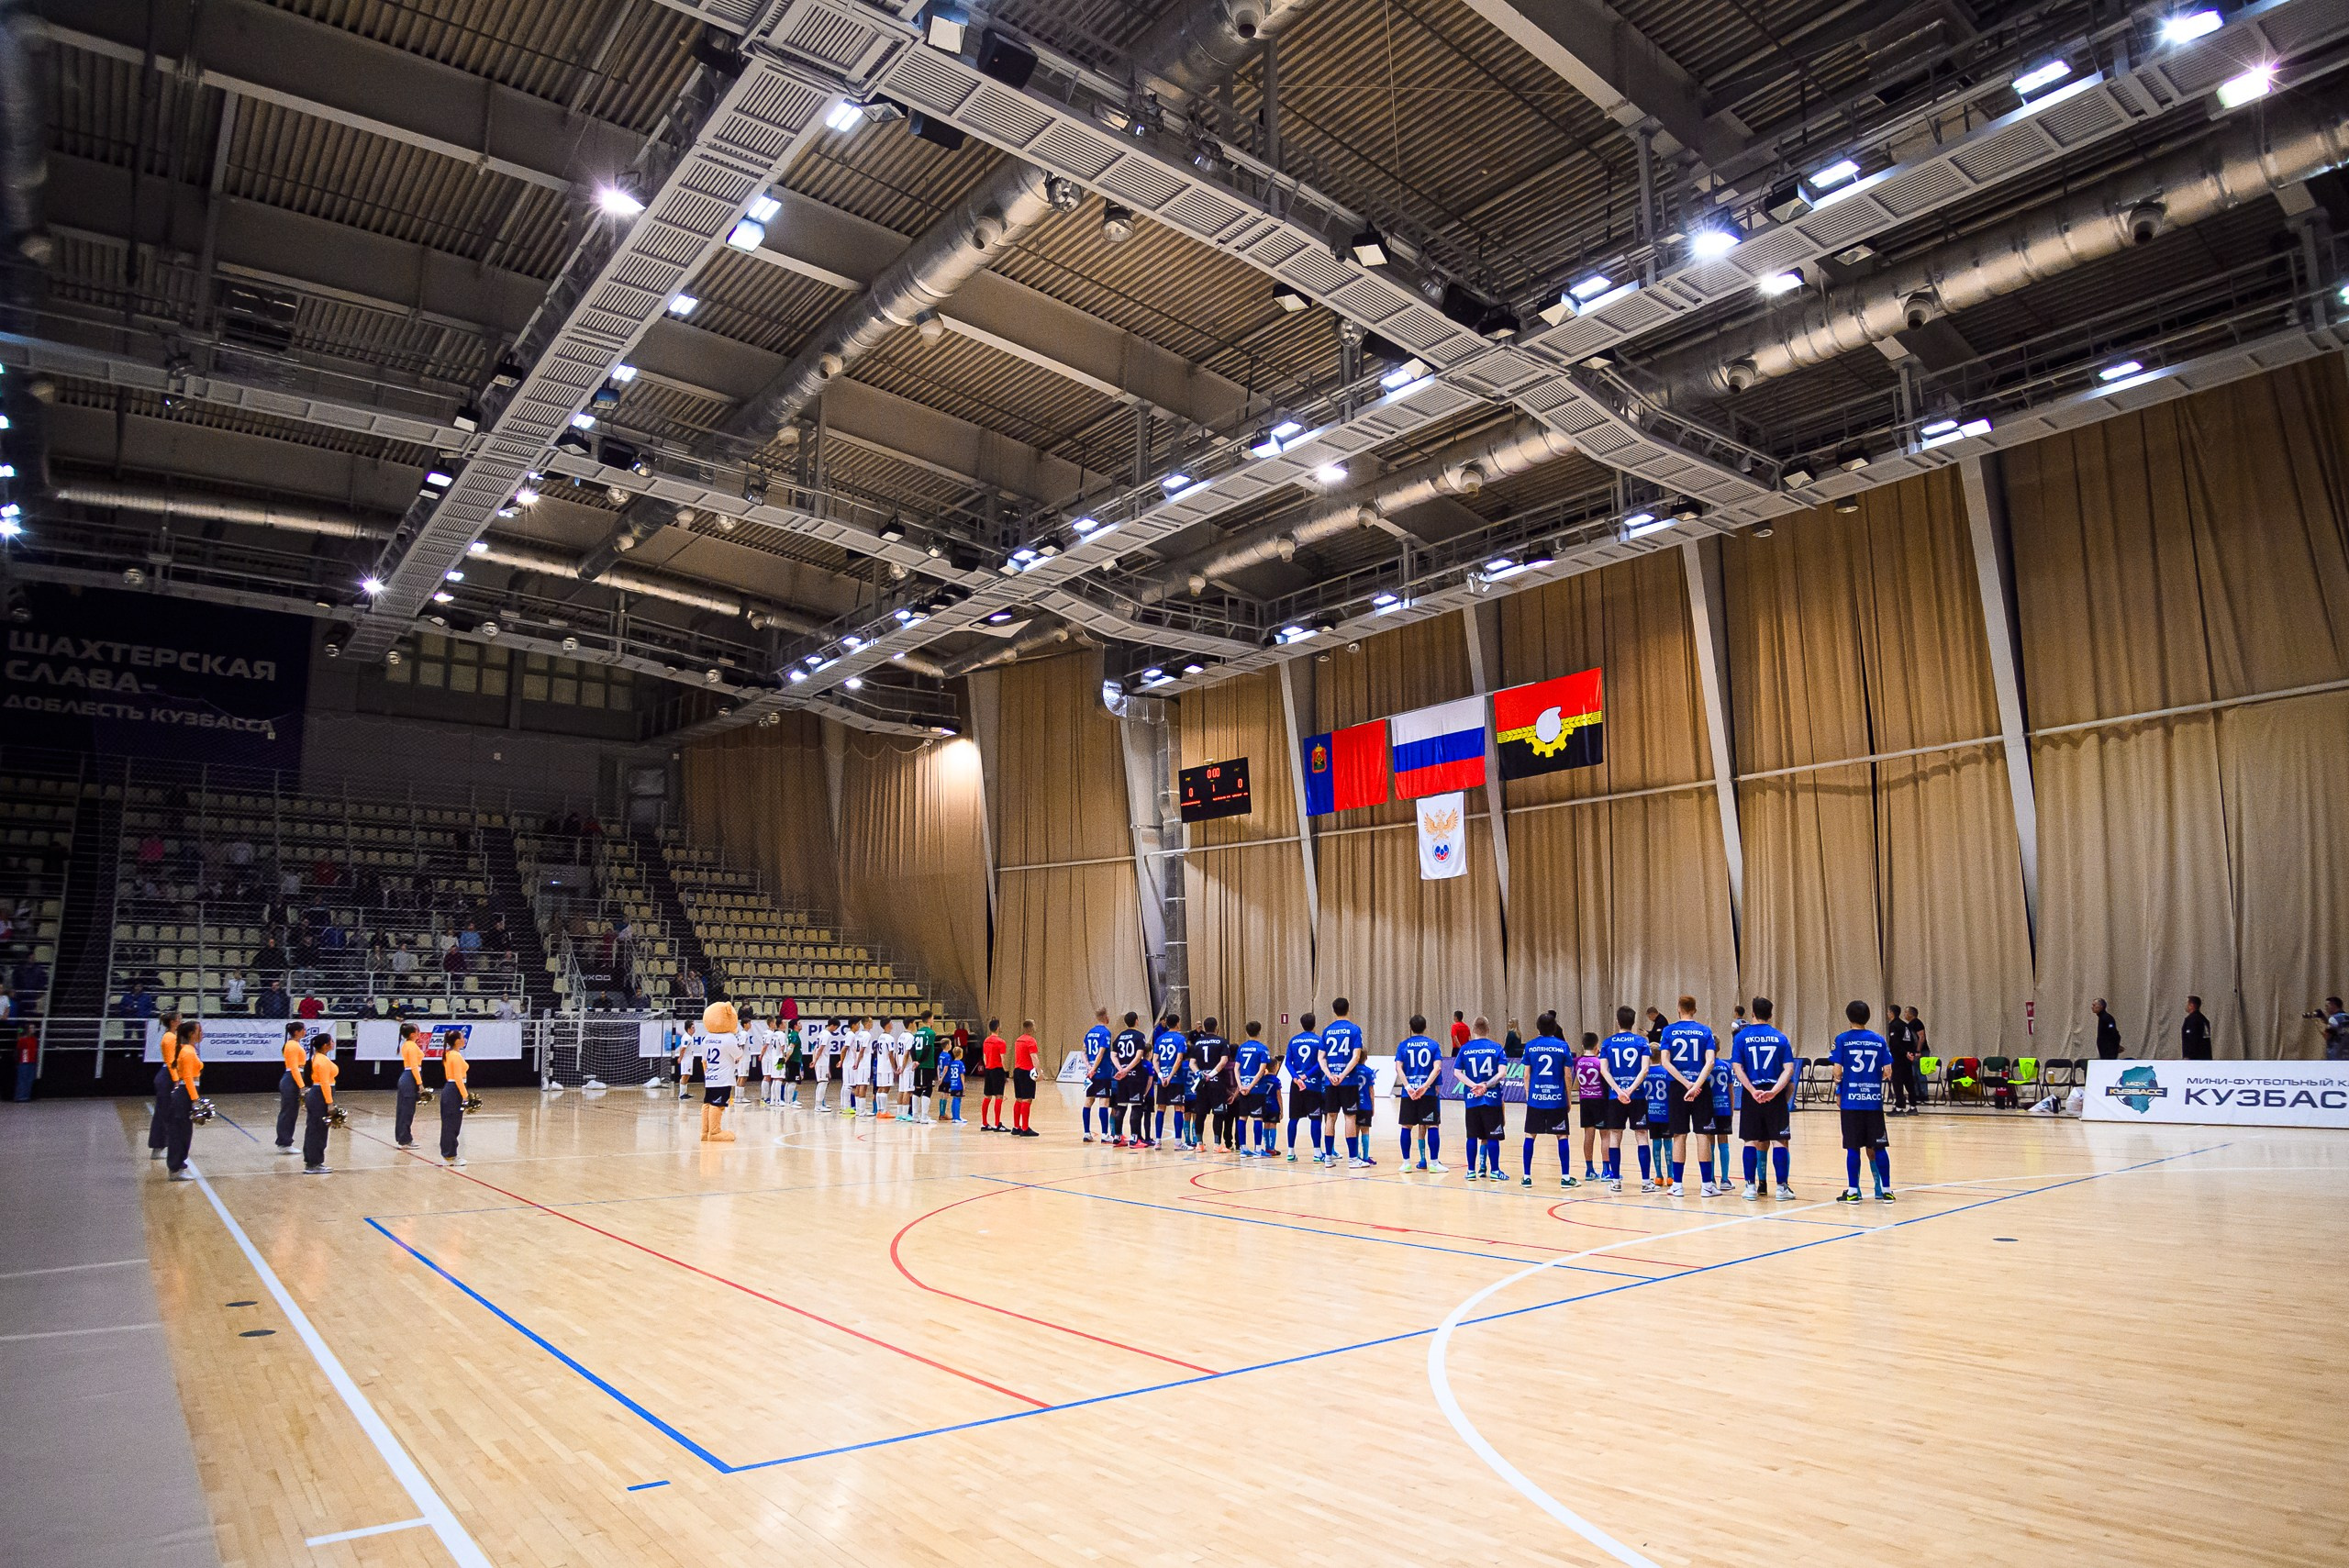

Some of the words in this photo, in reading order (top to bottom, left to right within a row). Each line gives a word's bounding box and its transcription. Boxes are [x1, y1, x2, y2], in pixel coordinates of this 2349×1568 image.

[9, 629, 276, 682] ШАХТЕРСКАЯ
[2, 694, 145, 720] ДОБЛЕСТЬ
[150, 706, 275, 733] КУЗБАССА
[1087, 1039, 1099, 1055] 13
[1118, 1040, 1135, 1058] 30
[1158, 1043, 1176, 1061] 29
[1202, 1045, 1208, 1062] 1
[1297, 1044, 1311, 1063] 9
[1326, 1037, 1350, 1056] 24
[1672, 1038, 1699, 1062] 21
[1242, 1052, 1252, 1069] 7
[1407, 1047, 1431, 1068] 10
[1468, 1056, 1494, 1077] 14
[1538, 1054, 1553, 1075] 2
[1611, 1047, 1639, 1068] 19
[1748, 1046, 1777, 1070] 17
[1848, 1049, 1878, 1073] 37
[1576, 1067, 1600, 1085] 62
[2187, 1076, 2333, 1087] МИНИ-ФУТБОЛЬНЫЙ
[1266, 1083, 1274, 1095] 7
[1643, 1079, 1667, 1101] 28
[1847, 1093, 1882, 1101] КУЗБАСС
[2109, 1087, 2165, 1095] КУЗБАСС
[2184, 1087, 2348, 1109] КУЗБАС
